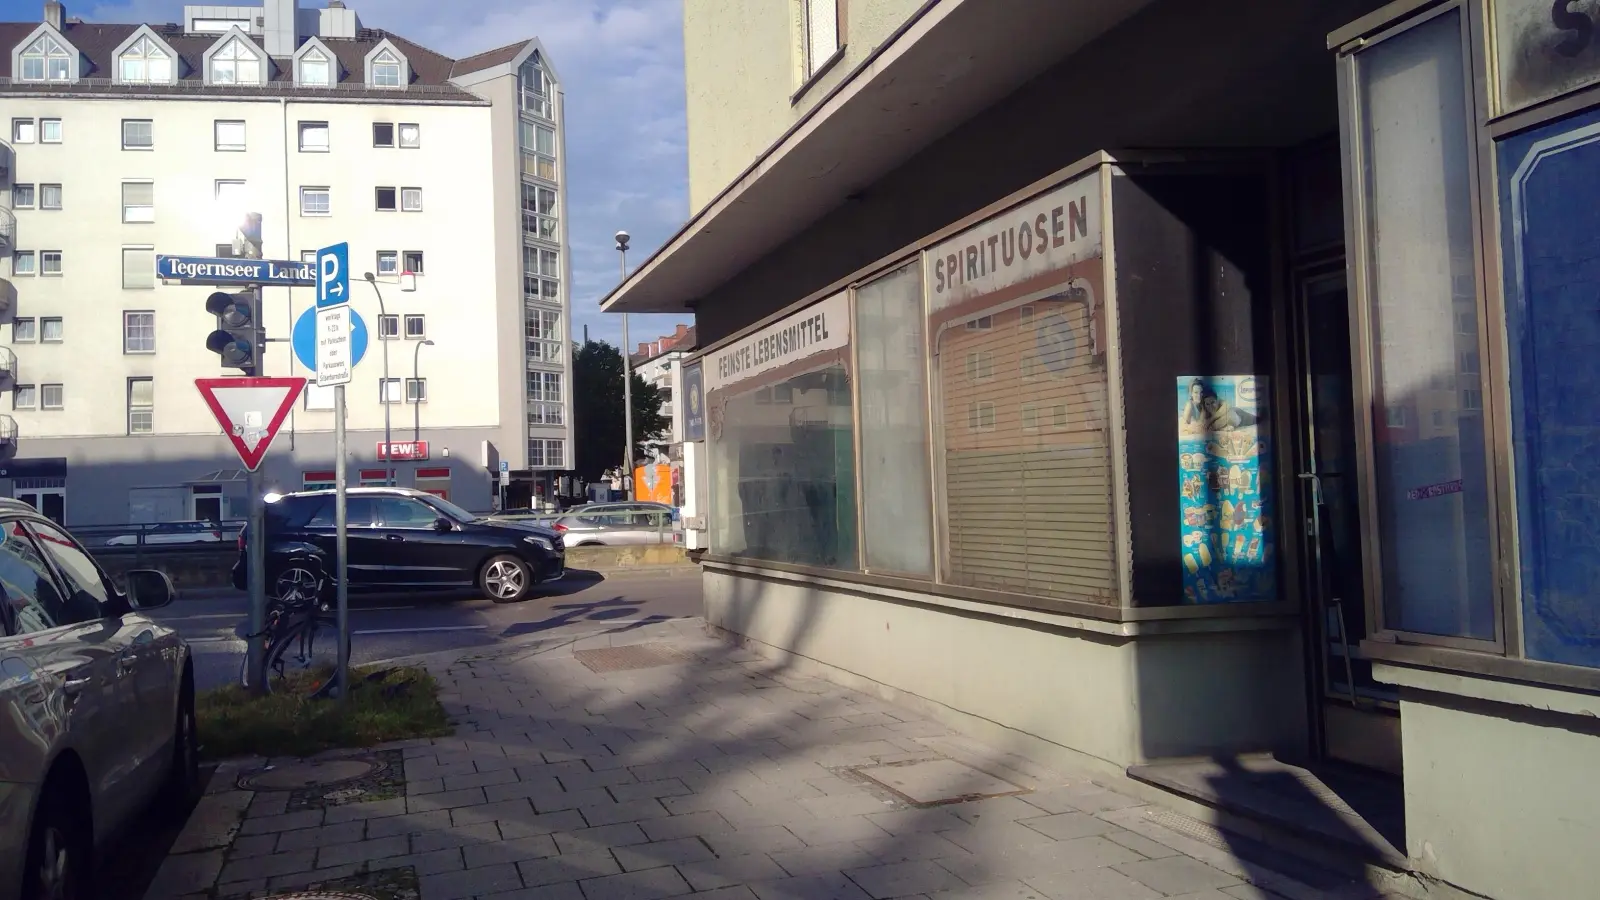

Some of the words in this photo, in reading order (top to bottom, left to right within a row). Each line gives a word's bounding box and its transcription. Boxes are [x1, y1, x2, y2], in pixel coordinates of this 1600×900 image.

[167, 258, 262, 278] Tegernseer
[935, 195, 1088, 294] SPIRITUOSEN
[321, 253, 339, 300] P
[718, 344, 751, 380] FEINSTE
[753, 312, 829, 367] LEBENSMITTEL
